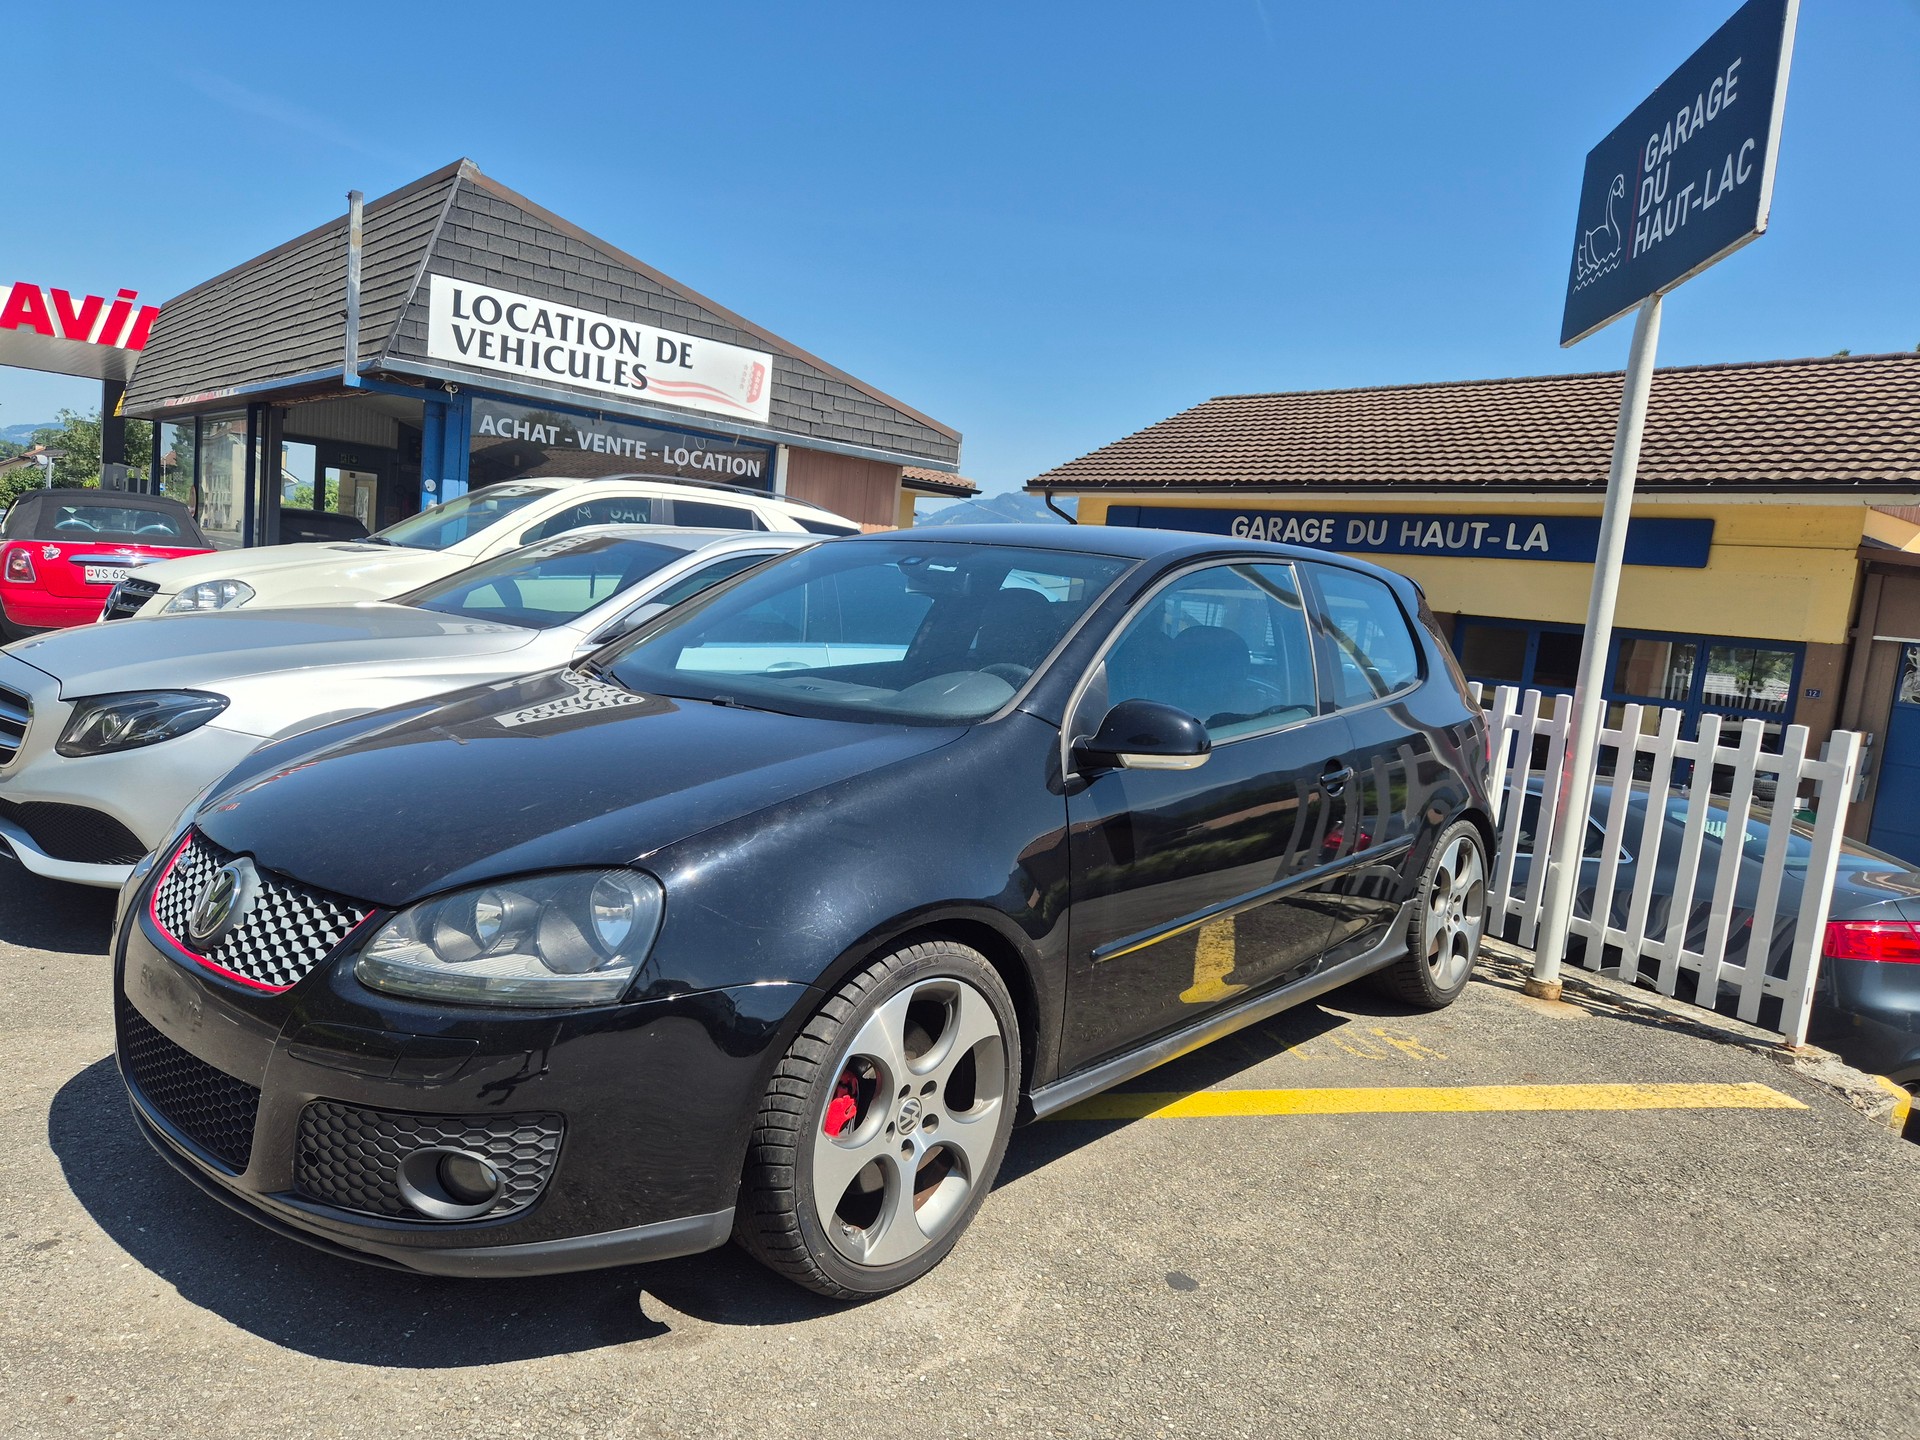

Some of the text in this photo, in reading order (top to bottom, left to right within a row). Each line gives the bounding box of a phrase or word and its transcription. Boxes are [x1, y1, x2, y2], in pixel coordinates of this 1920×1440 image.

[1644, 56, 1742, 173] GARAGE
[1632, 137, 1755, 259] HAUT-LAC
[1638, 161, 1671, 218] DU
[450, 323, 649, 391] VEHICULES
[452, 288, 694, 370] LOCATION DE
[478, 414, 560, 446] ACHAT
[578, 431, 647, 461] VENTE
[663, 445, 761, 478] LOCATION
[1231, 515, 1549, 552] GARAGE DU HAUT-LA
[94, 568, 109, 579] VS
